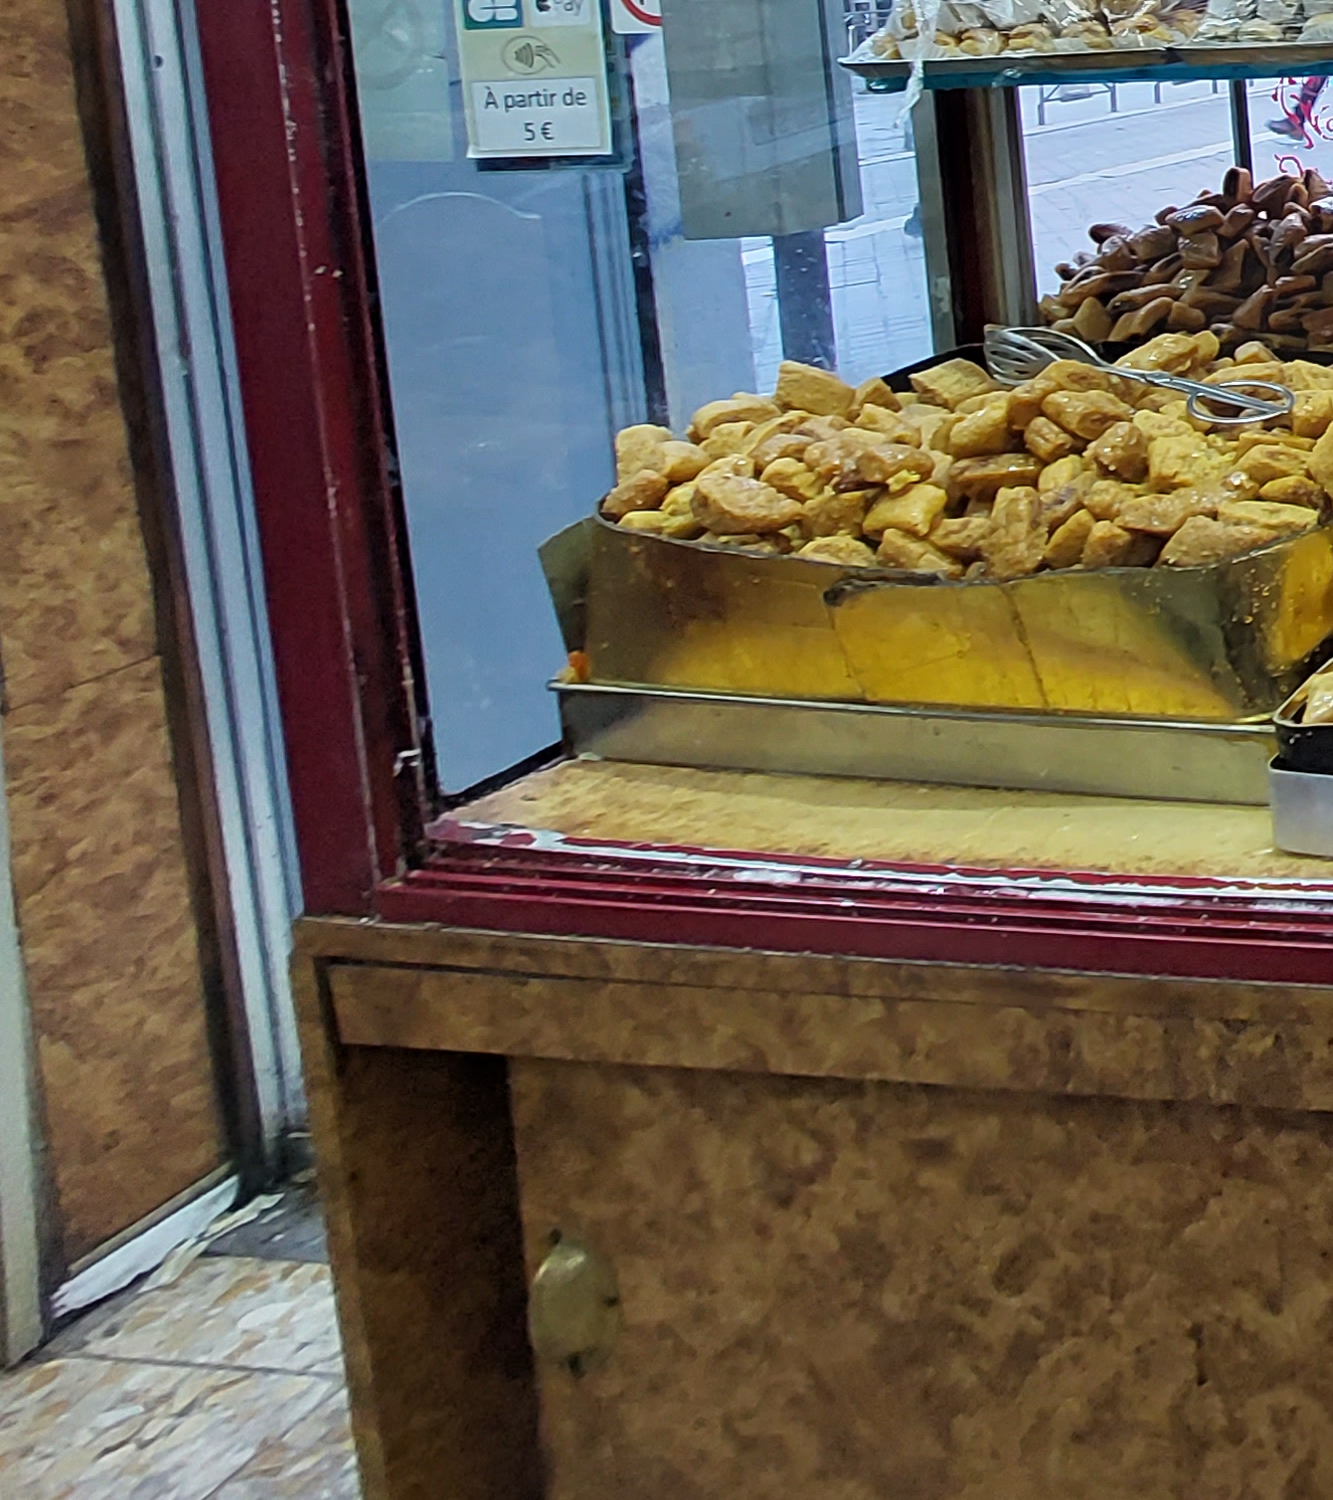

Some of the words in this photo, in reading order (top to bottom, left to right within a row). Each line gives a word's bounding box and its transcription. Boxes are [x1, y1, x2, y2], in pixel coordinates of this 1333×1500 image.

[484, 86, 499, 110] À
[504, 89, 557, 113] partir
[562, 88, 588, 107] de
[524, 122, 536, 142] 5
[540, 121, 555, 141] €
